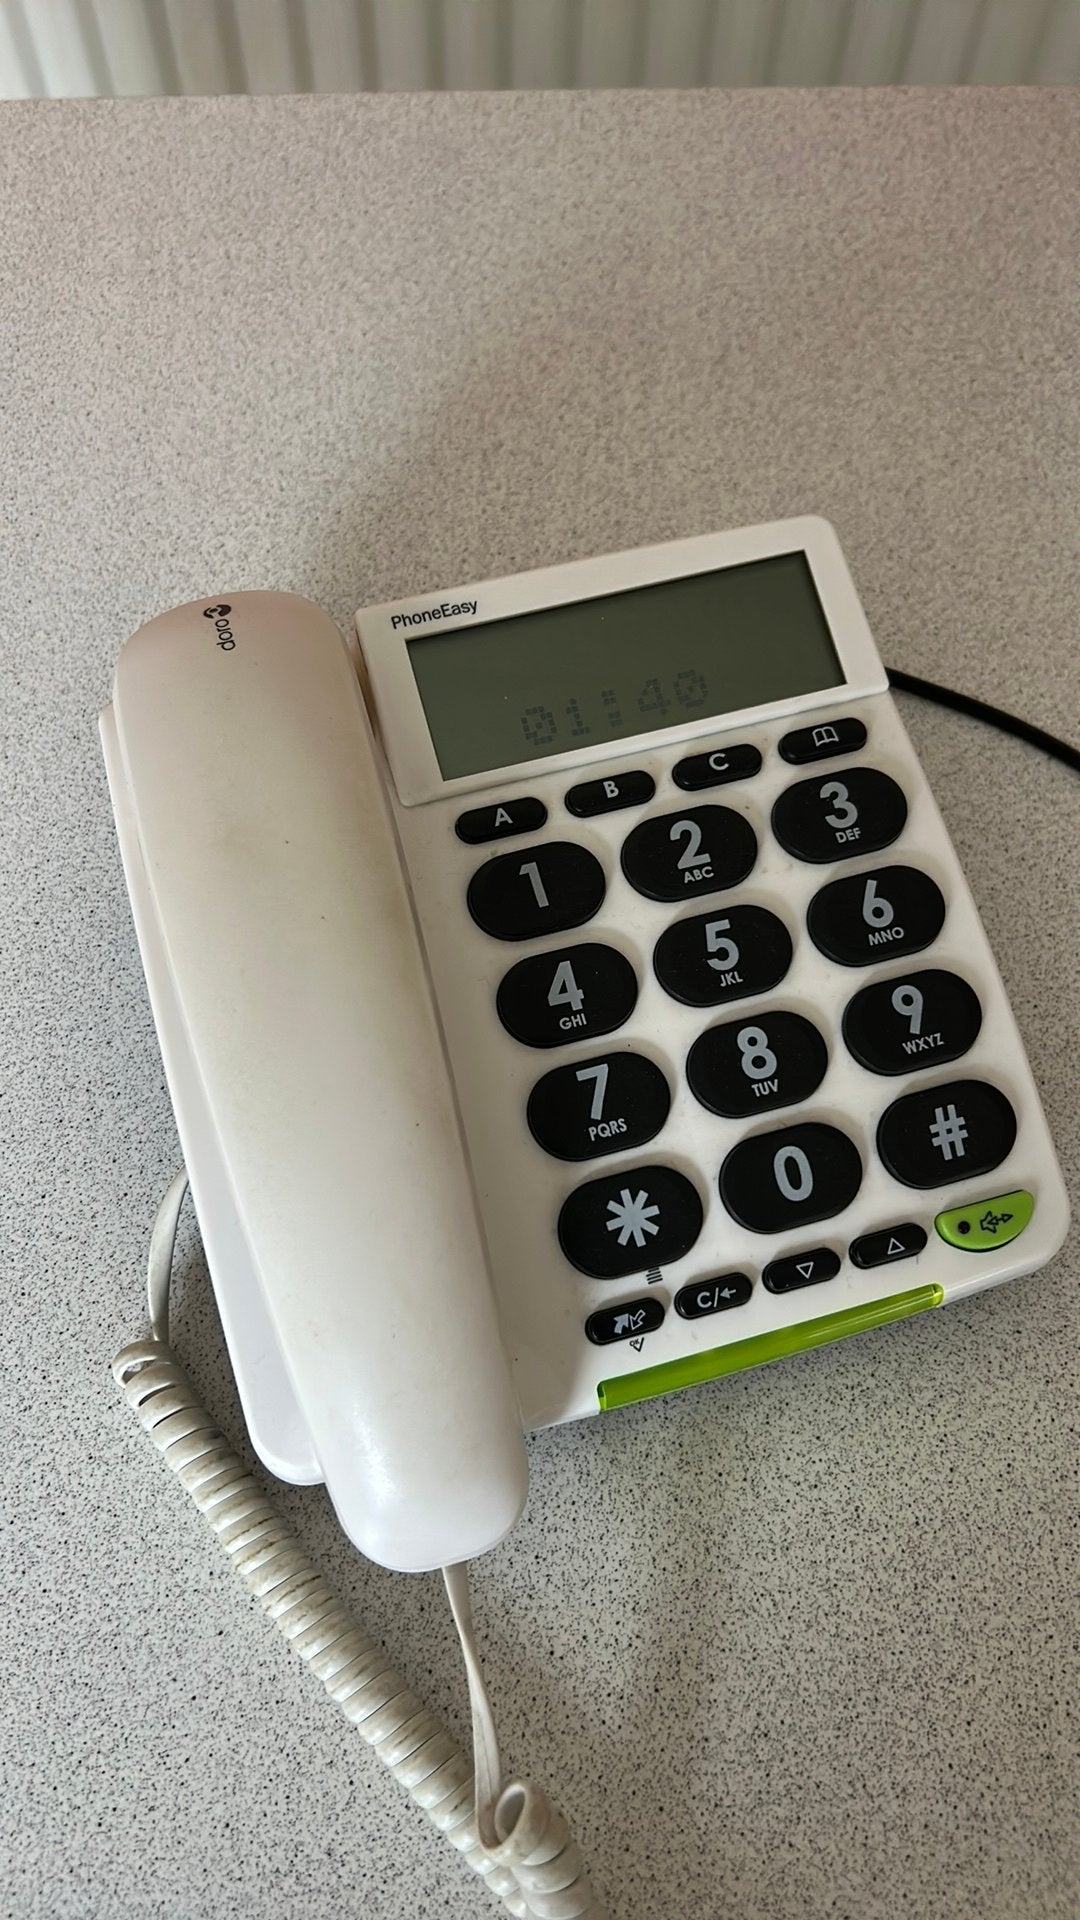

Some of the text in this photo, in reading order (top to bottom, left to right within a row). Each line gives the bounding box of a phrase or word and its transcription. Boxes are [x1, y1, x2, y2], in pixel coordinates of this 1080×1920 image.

[391, 601, 477, 630] PhoneEasy
[215, 618, 236, 651] doro
[709, 753, 729, 771] C
[603, 781, 619, 799] B
[820, 782, 859, 829] 3
[494, 807, 513, 827] A
[670, 820, 711, 869] 2
[835, 826, 861, 843] DEF
[519, 862, 549, 908] 1
[684, 866, 714, 884] ABC
[863, 880, 894, 928] 6
[705, 919, 739, 971] 5
[869, 926, 905, 947] MNO
[547, 961, 585, 1011] 4
[720, 971, 744, 987] JKL
[559, 1013, 587, 1030] GHI
[891, 985, 924, 1035] 9
[737, 1026, 777, 1080] 8
[902, 1032, 945, 1055] WXYZ
[576, 1063, 609, 1120] 7
[751, 1079, 779, 1098] TUV
[588, 1117, 628, 1142] PQRS
[929, 1104, 968, 1161] #
[773, 1146, 814, 1201] 0
